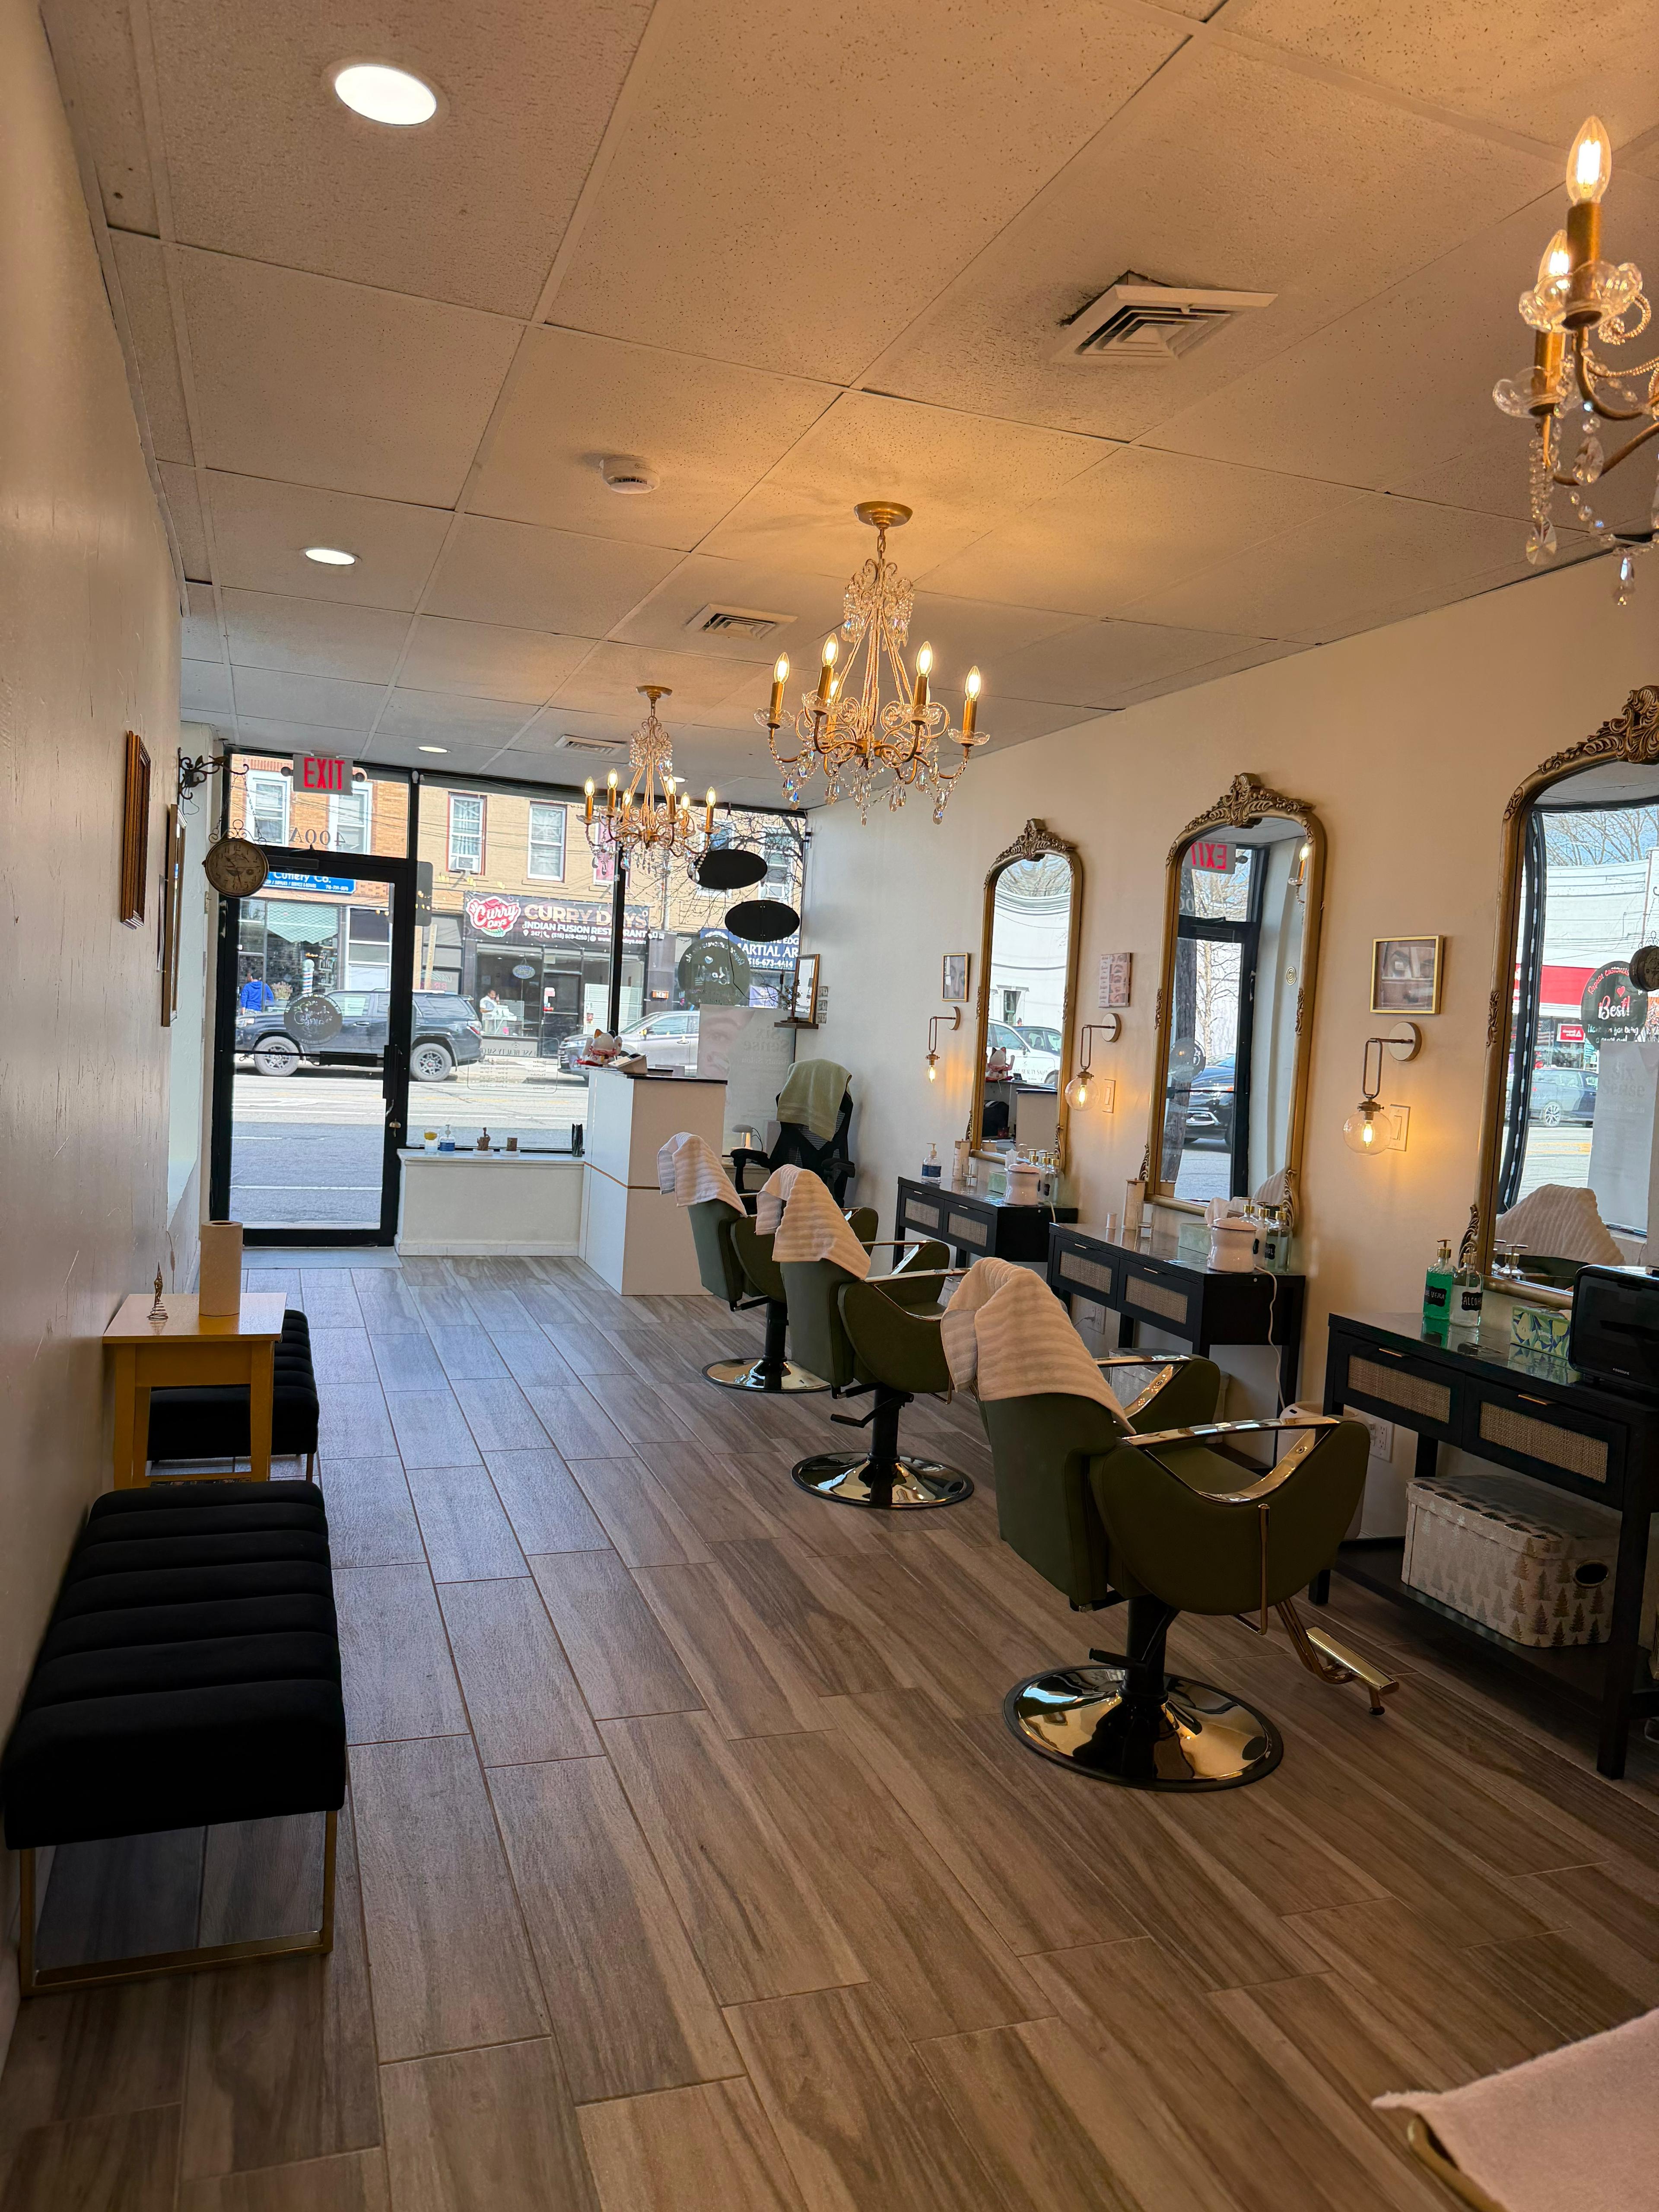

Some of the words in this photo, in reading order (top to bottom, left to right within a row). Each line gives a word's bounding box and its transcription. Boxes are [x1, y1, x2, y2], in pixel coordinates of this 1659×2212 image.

[304, 757, 345, 790] EXIT
[474, 905, 518, 926] Curry
[524, 904, 593, 925] CURRY
[596, 910, 647, 928] DYS
[523, 921, 556, 931] INDIAN
[557, 924, 590, 934] FUSION
[591, 926, 648, 938] RESTRANT
[1587, 973, 1604, 995] Repeat
[1598, 995, 1630, 1020] Best!
[1431, 1291, 1445, 1300] VERA
